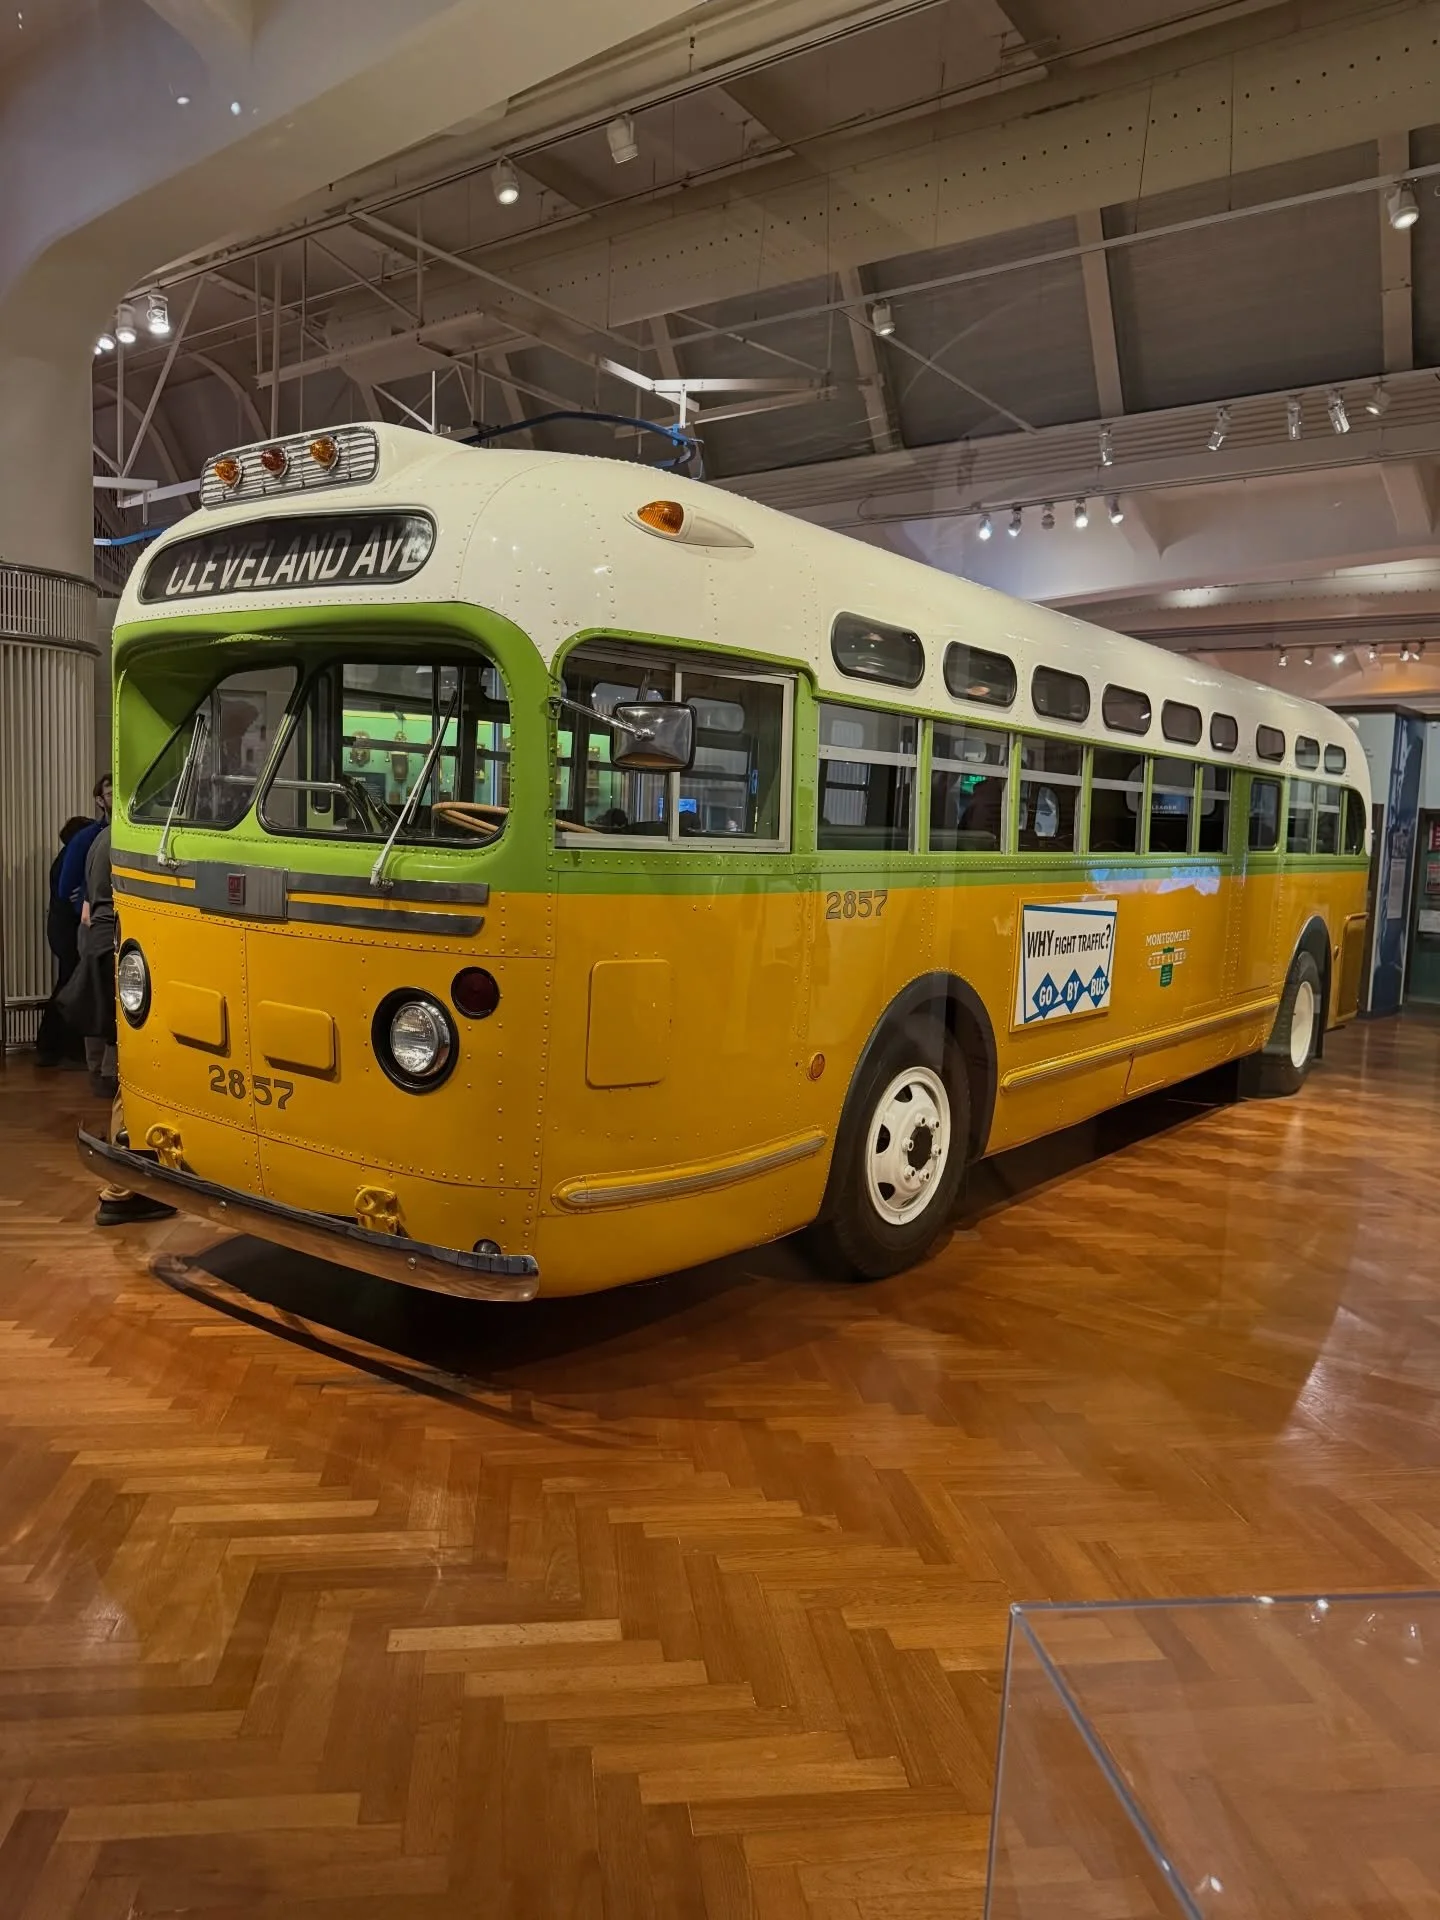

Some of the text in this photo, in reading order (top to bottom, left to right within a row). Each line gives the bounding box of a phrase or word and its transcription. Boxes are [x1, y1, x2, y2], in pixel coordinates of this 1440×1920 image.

[165, 529, 352, 595] CLEVELAND
[826, 890, 888, 919] 2857
[1028, 924, 1112, 958] WHY FIGHT TRAFFIC?
[1146, 929, 1191, 946] MONTGOMERY
[1039, 977, 1106, 1007] GO BY BUS
[208, 1064, 294, 1110] 2857
